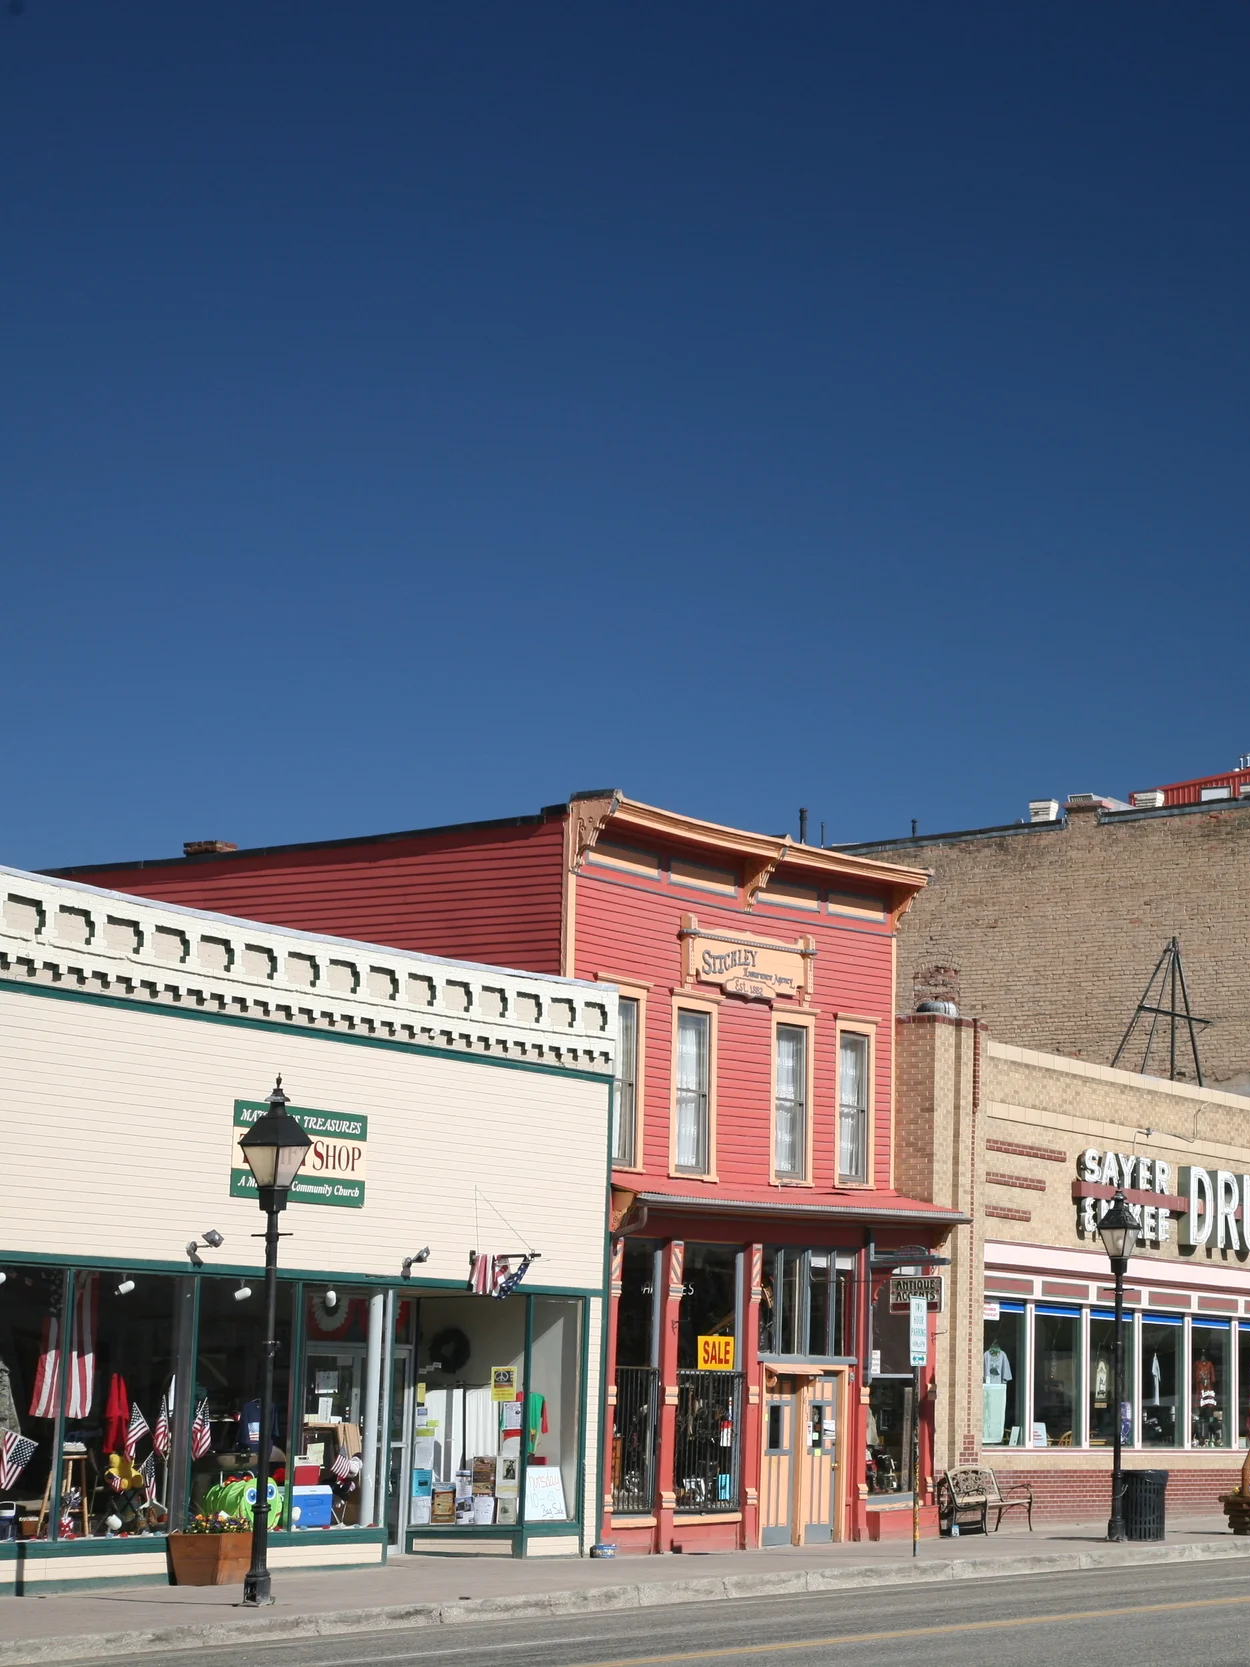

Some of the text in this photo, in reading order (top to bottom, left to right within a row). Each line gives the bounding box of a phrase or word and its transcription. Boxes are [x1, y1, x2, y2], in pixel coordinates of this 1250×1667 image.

[303, 1116, 362, 1135] TREASURES
[312, 1140, 362, 1171] SHOP
[1080, 1148, 1172, 1196] SAYER
[291, 1181, 333, 1197] Community
[334, 1185, 360, 1198] Church
[896, 1280, 936, 1290] ANTIQUE
[895, 1290, 936, 1302] ACCENTS
[702, 1340, 730, 1365] SALE
[526, 1470, 561, 1491] hursday
